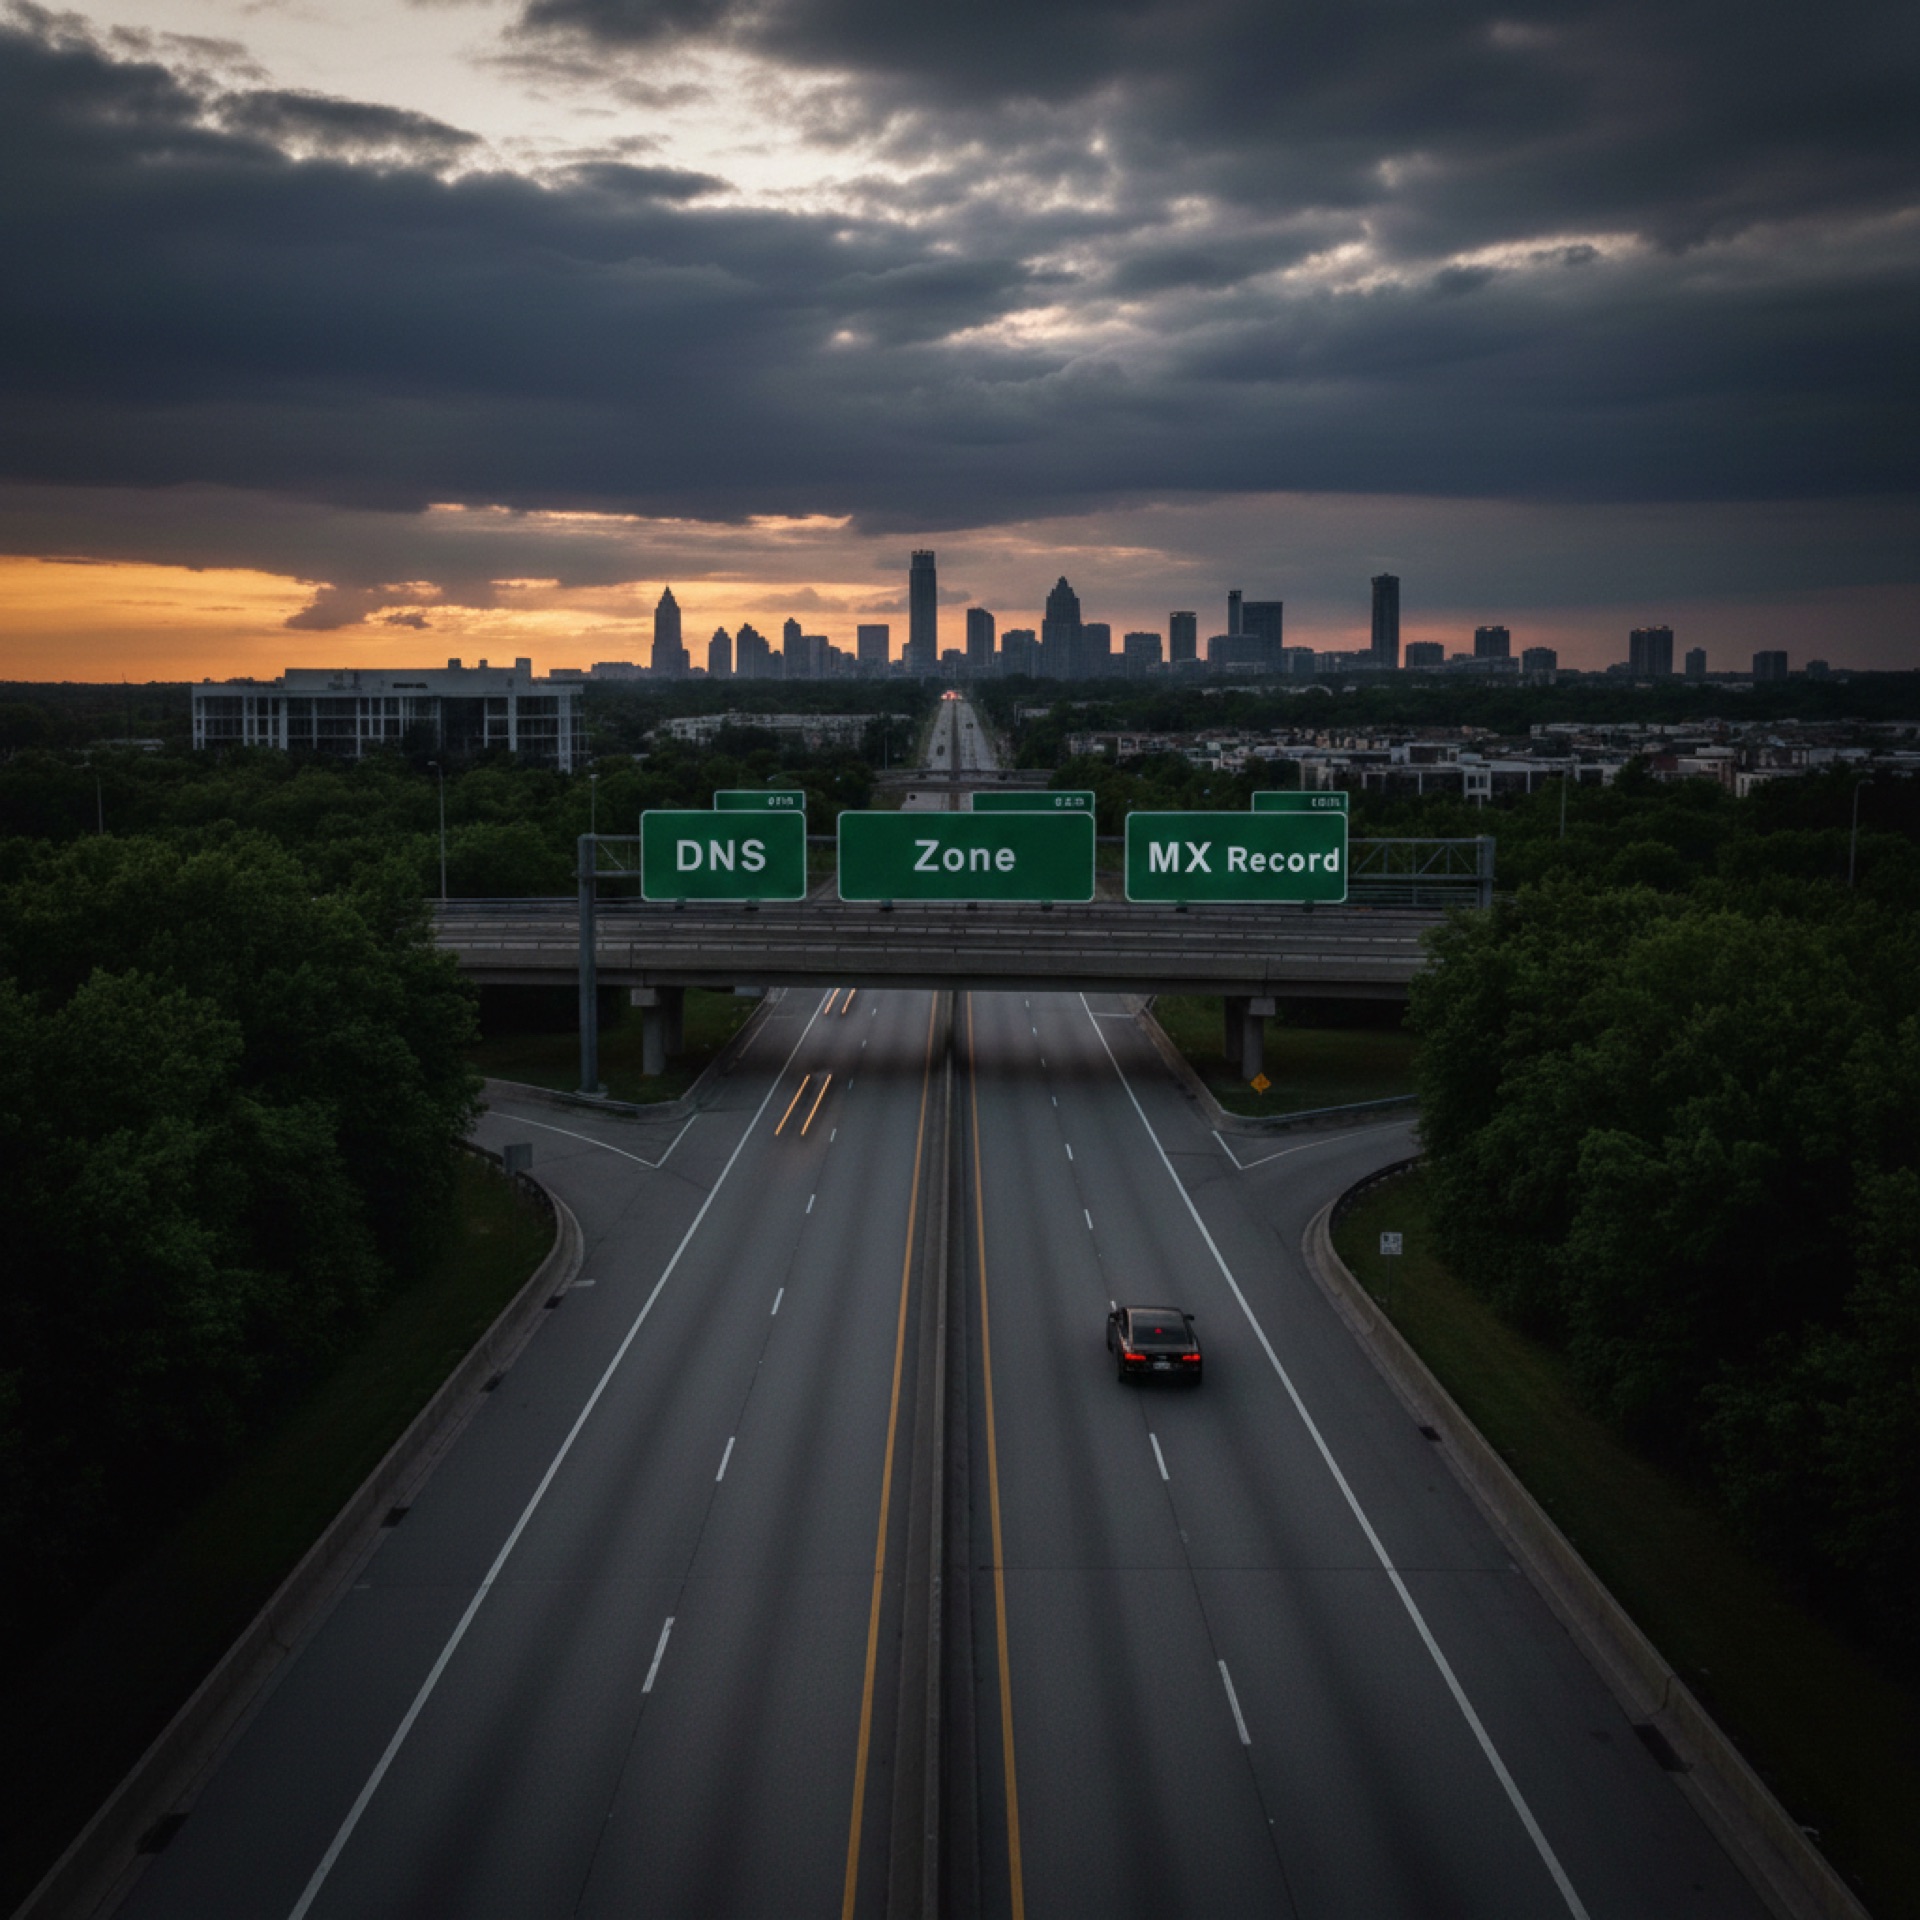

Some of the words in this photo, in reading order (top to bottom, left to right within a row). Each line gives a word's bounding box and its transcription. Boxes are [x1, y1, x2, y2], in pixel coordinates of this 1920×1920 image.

[676, 839, 766, 872] DNS
[914, 839, 1016, 872] Zone
[1148, 841, 1212, 873] MX
[1227, 845, 1340, 873] Record
